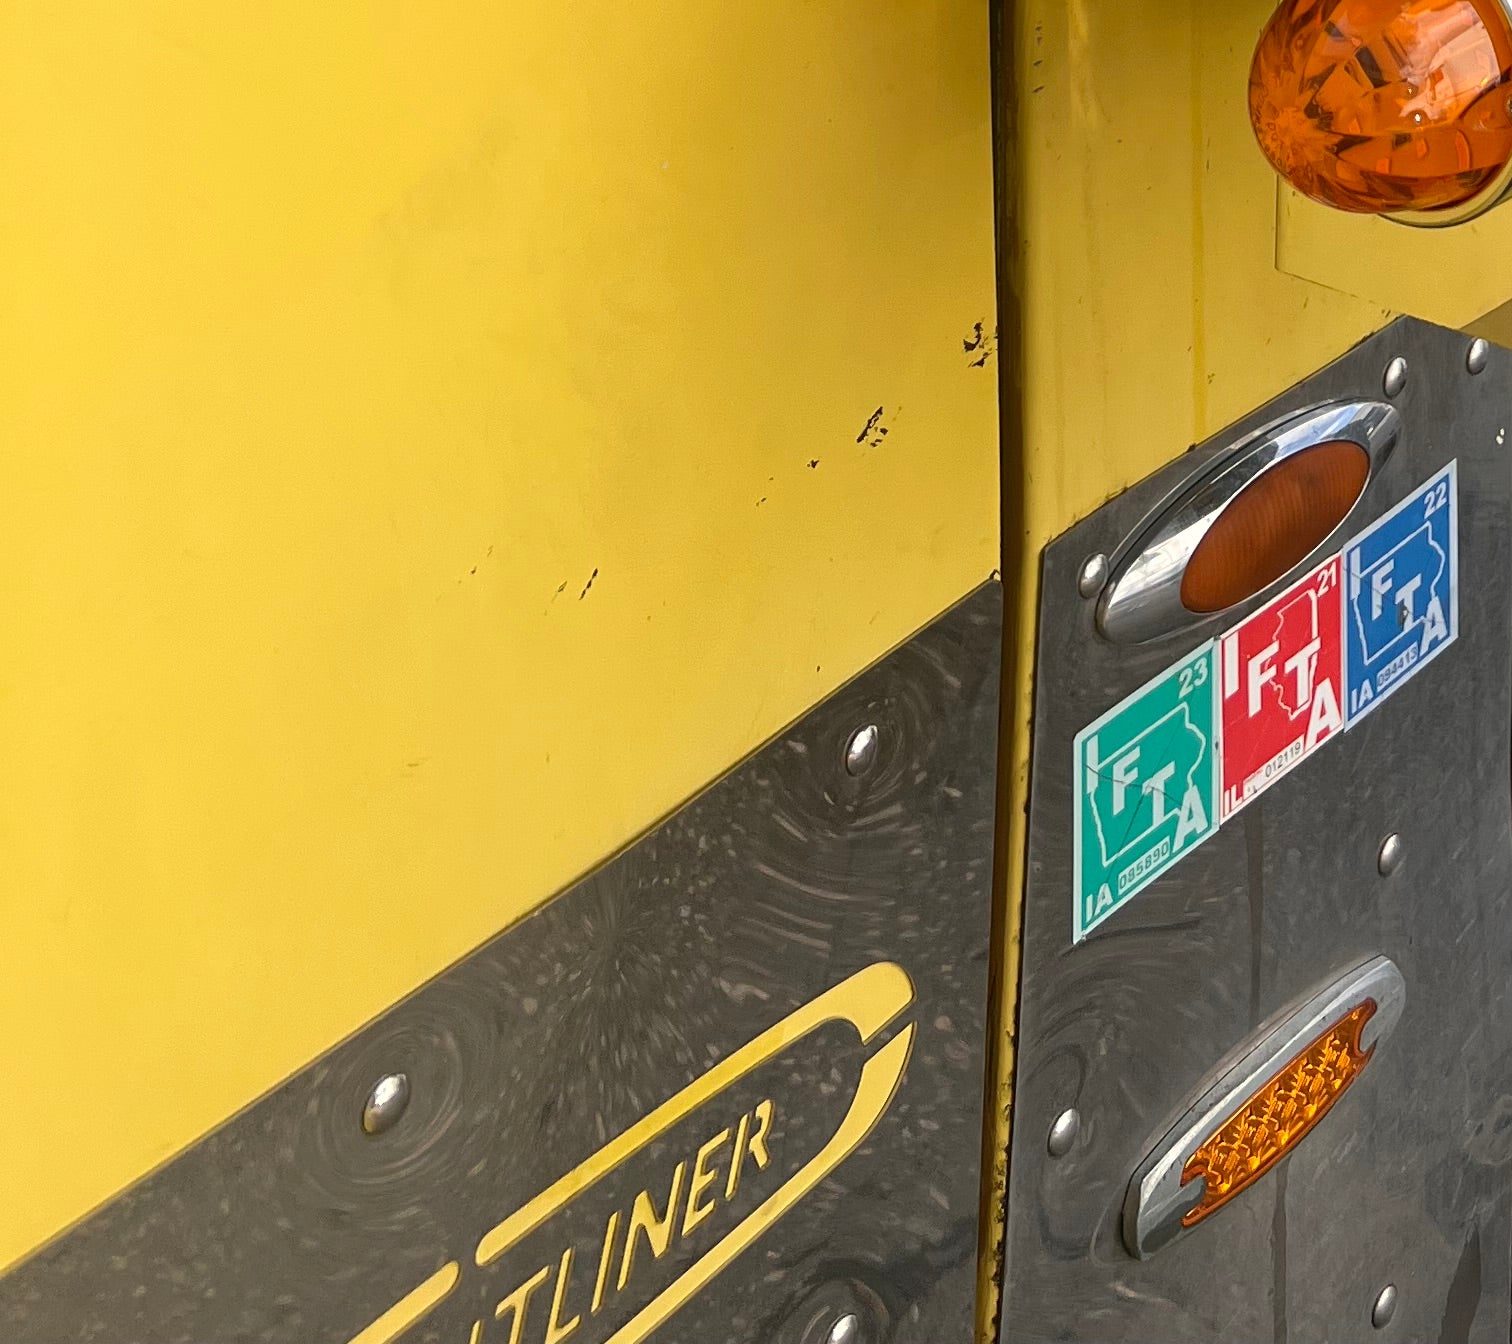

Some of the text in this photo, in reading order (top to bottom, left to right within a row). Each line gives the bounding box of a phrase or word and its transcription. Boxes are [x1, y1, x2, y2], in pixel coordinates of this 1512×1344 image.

[1424, 481, 1448, 520] 22
[1315, 561, 1337, 599] 21
[1350, 545, 1448, 658] IFTA
[1178, 657, 1209, 699] 23
[1225, 631, 1342, 753] IFTA
[1351, 678, 1374, 715] IA
[1086, 734, 1209, 853] IFTA
[1224, 741, 1301, 814] IL 012119
[1086, 882, 1114, 923] IA
[468, 1098, 774, 1344] TLINER
